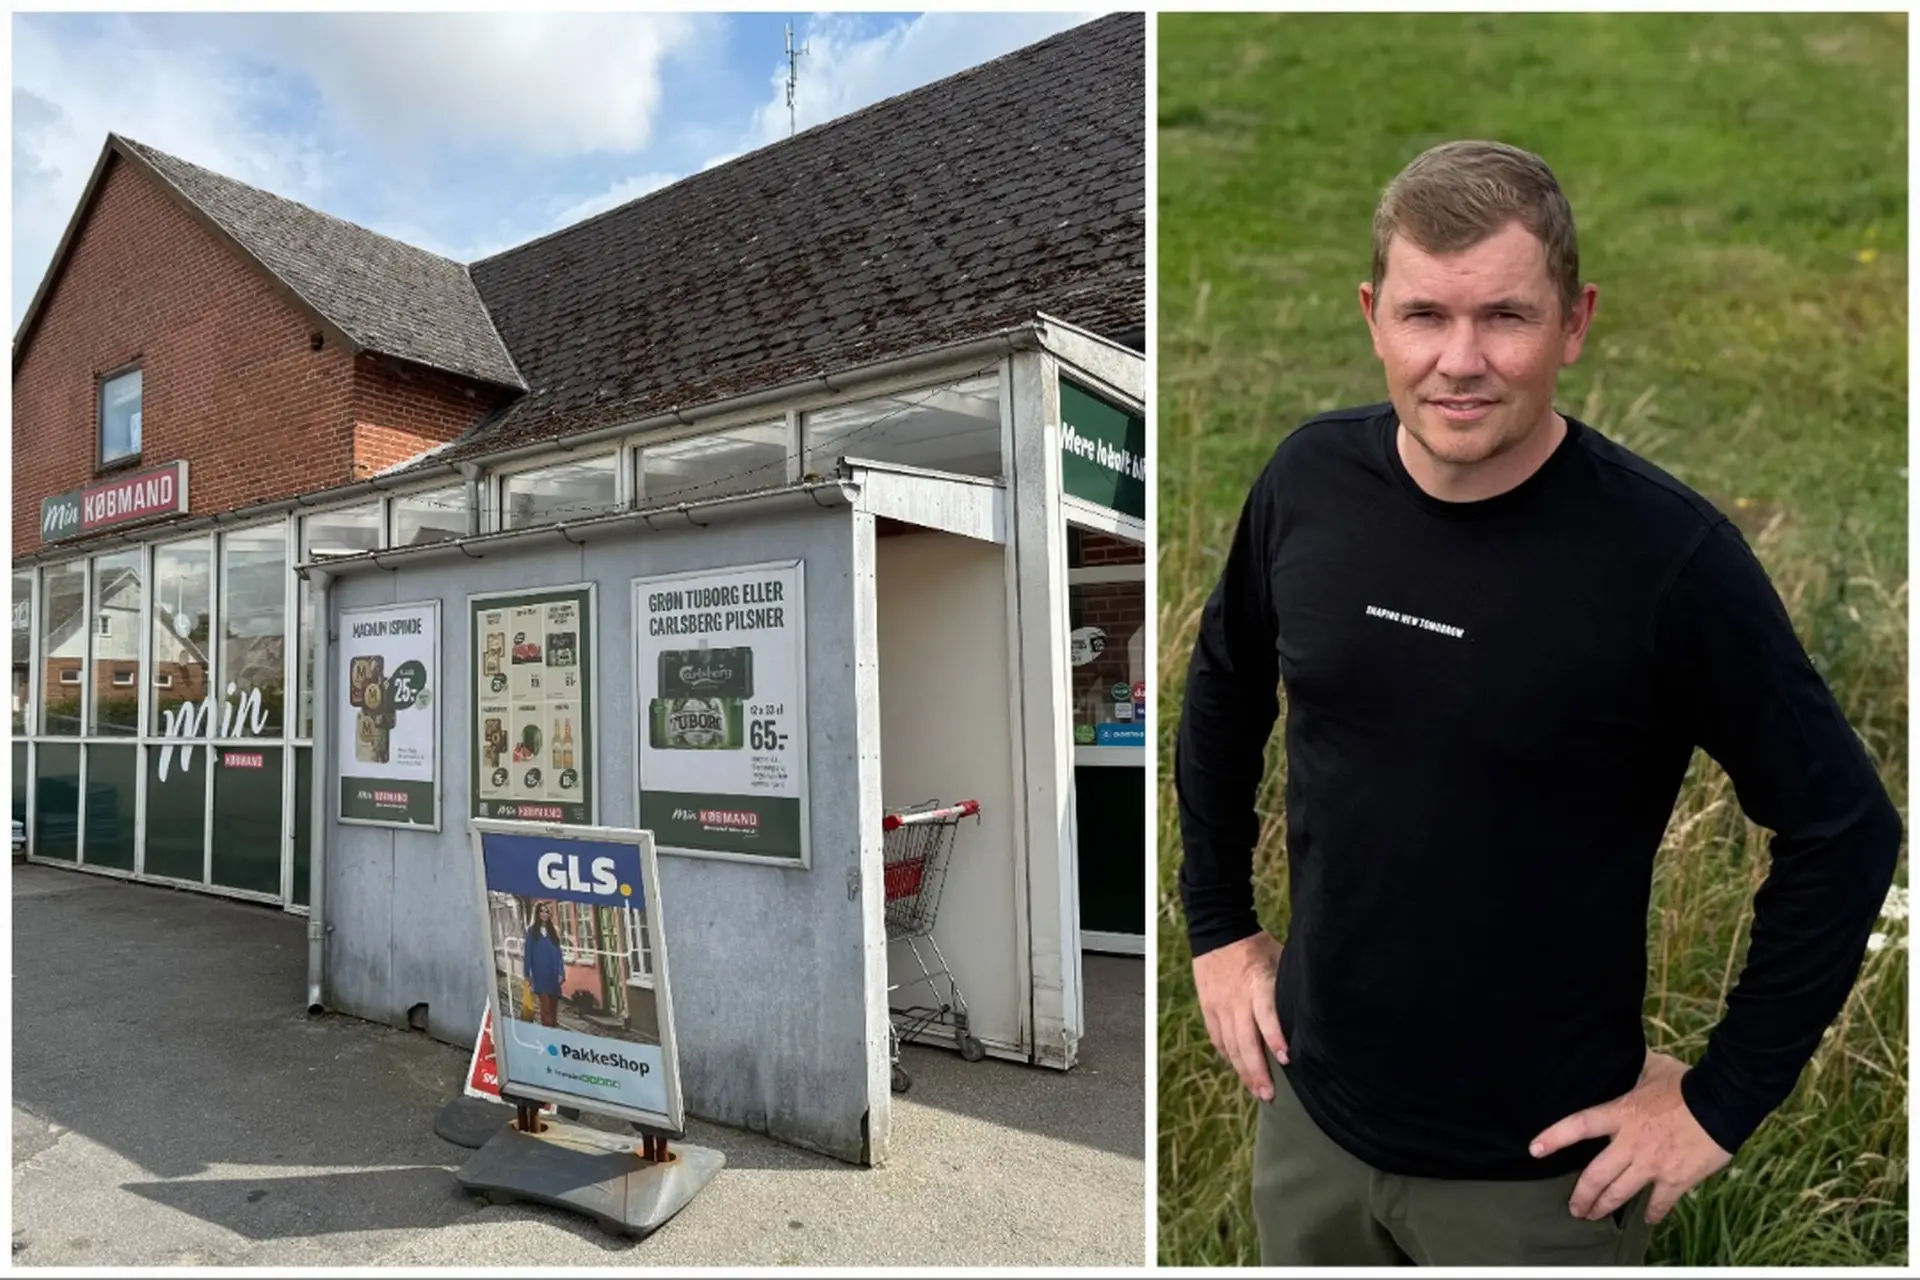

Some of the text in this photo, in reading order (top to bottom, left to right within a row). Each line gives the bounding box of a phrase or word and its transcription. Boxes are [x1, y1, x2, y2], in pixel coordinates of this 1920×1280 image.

[1061, 421, 1094, 461] Mere
[1097, 438, 1130, 475] lokalt
[43, 475, 173, 533] Min KØBMAND
[648, 581, 784, 613] GRØN TUBORG ELLER
[650, 607, 784, 636] CARLSBERG PILSNER
[1365, 605, 1465, 638] SHAPING NEW TOMORROW
[159, 681, 269, 782] Min
[699, 811, 757, 826] KØBMAND
[561, 1044, 650, 1078] PakkeShop
